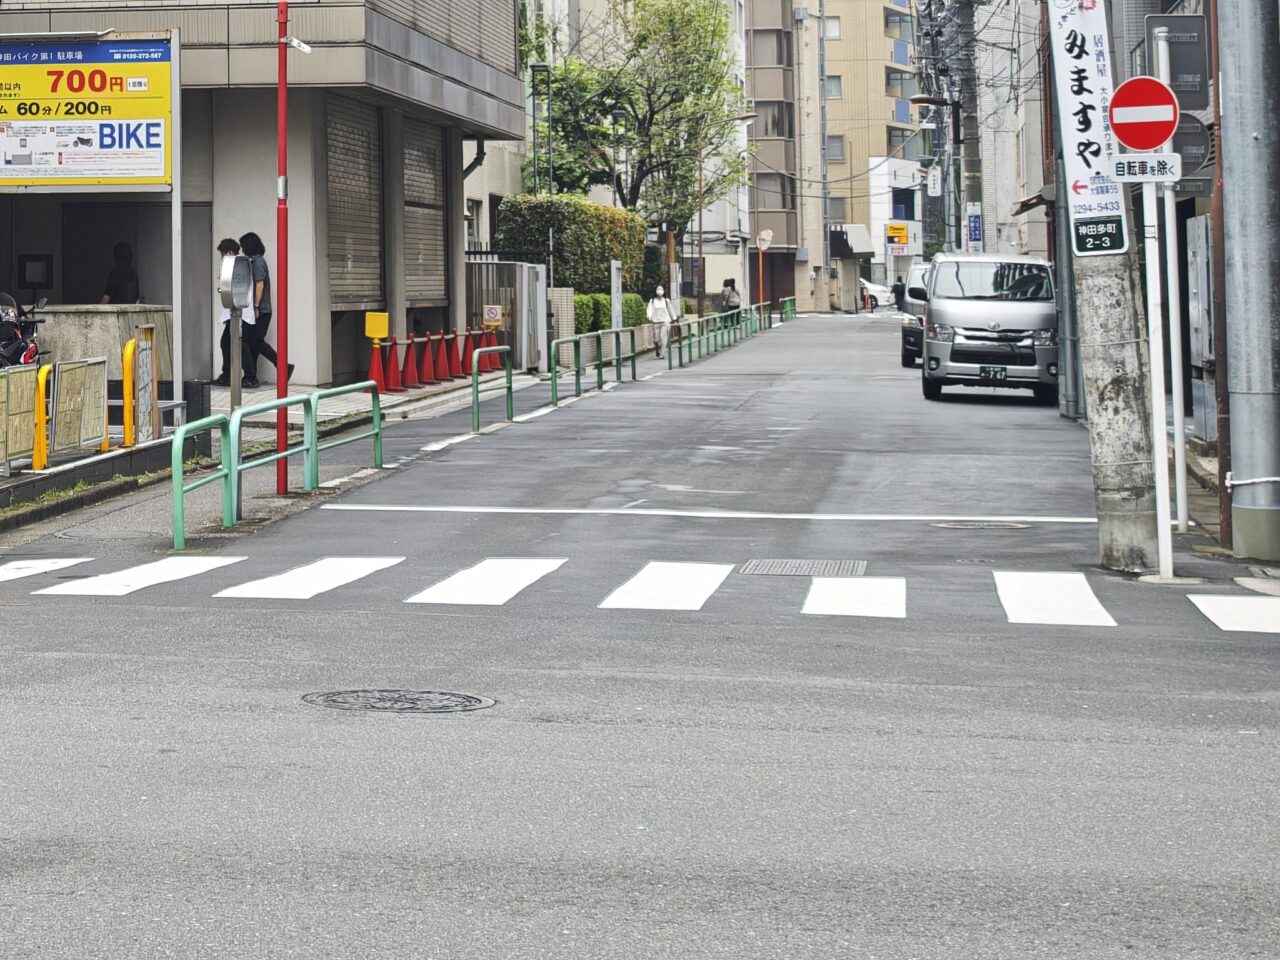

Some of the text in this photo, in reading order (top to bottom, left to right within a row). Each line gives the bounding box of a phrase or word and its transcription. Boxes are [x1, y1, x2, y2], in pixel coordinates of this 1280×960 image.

[46, 69, 124, 93] 700円
[1064, 29, 1102, 169] みますや
[98, 122, 162, 149] BIKE
[1115, 160, 1175, 176] 自転車を除く
[1078, 223, 1117, 236] 神田多町
[1086, 237, 1111, 249] 2-3
